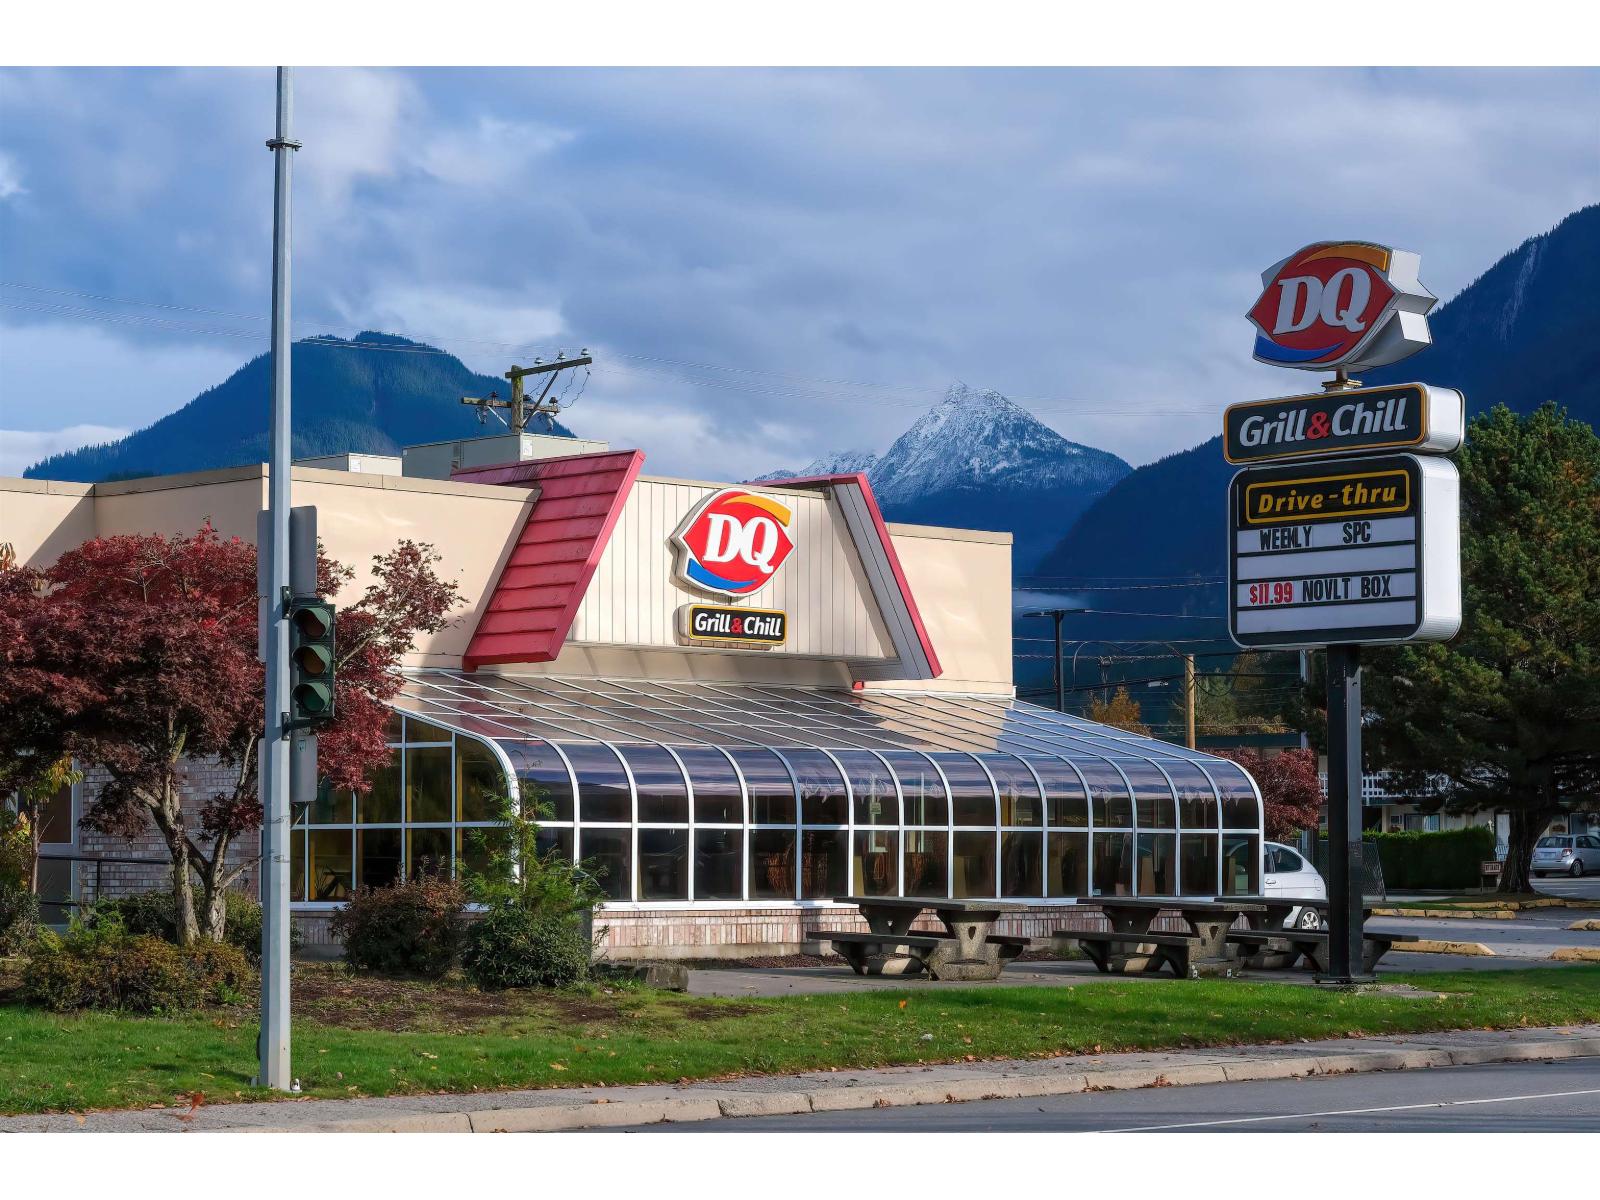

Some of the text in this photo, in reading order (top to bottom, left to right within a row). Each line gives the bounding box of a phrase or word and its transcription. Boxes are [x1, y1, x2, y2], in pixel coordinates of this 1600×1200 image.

[1272, 267, 1372, 336] DQ
[702, 512, 779, 574] DQ
[1342, 521, 1371, 544] SPC
[1249, 575, 1392, 605] $11.99 NOVLT BOX
